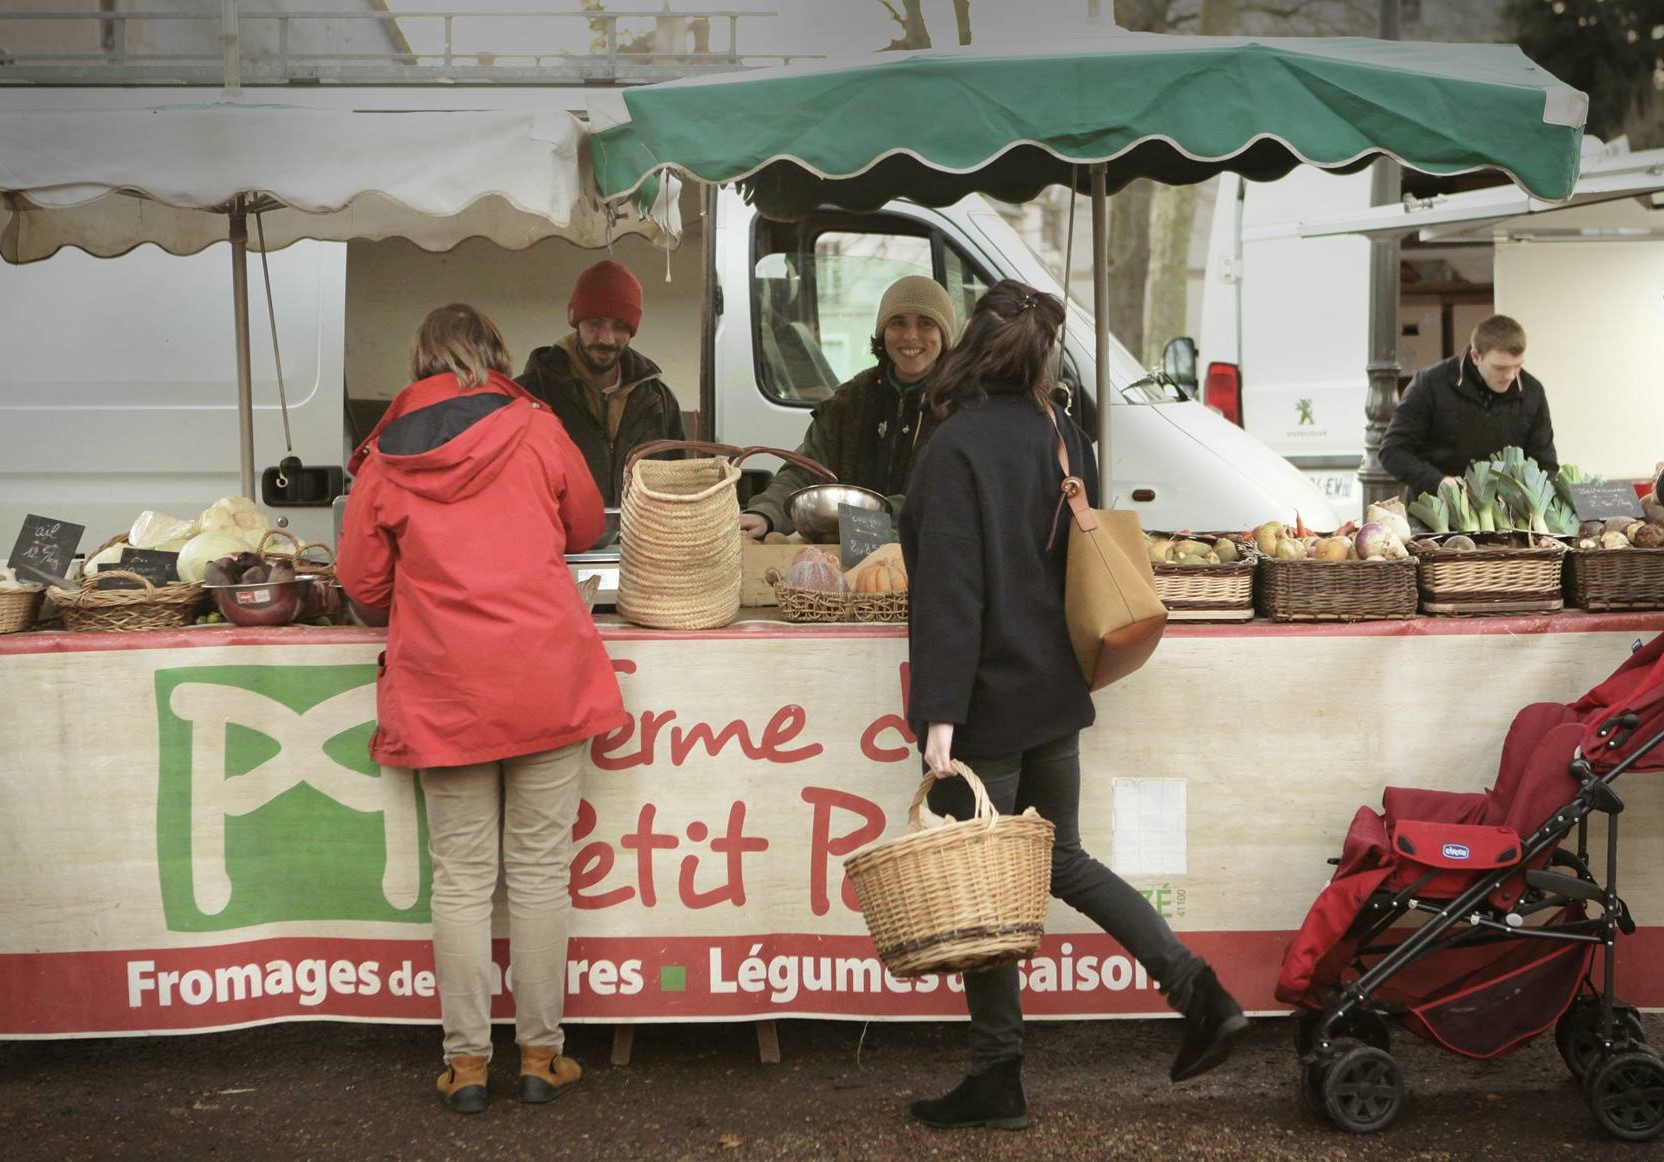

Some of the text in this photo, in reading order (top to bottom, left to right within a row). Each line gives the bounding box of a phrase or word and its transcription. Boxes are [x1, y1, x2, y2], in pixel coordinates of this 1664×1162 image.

[591, 659, 824, 771] erme
[568, 798, 770, 911] etit
[1176, 889, 1187, 918] 41100
[127, 957, 380, 1008] Fromages
[388, 964, 436, 998] de
